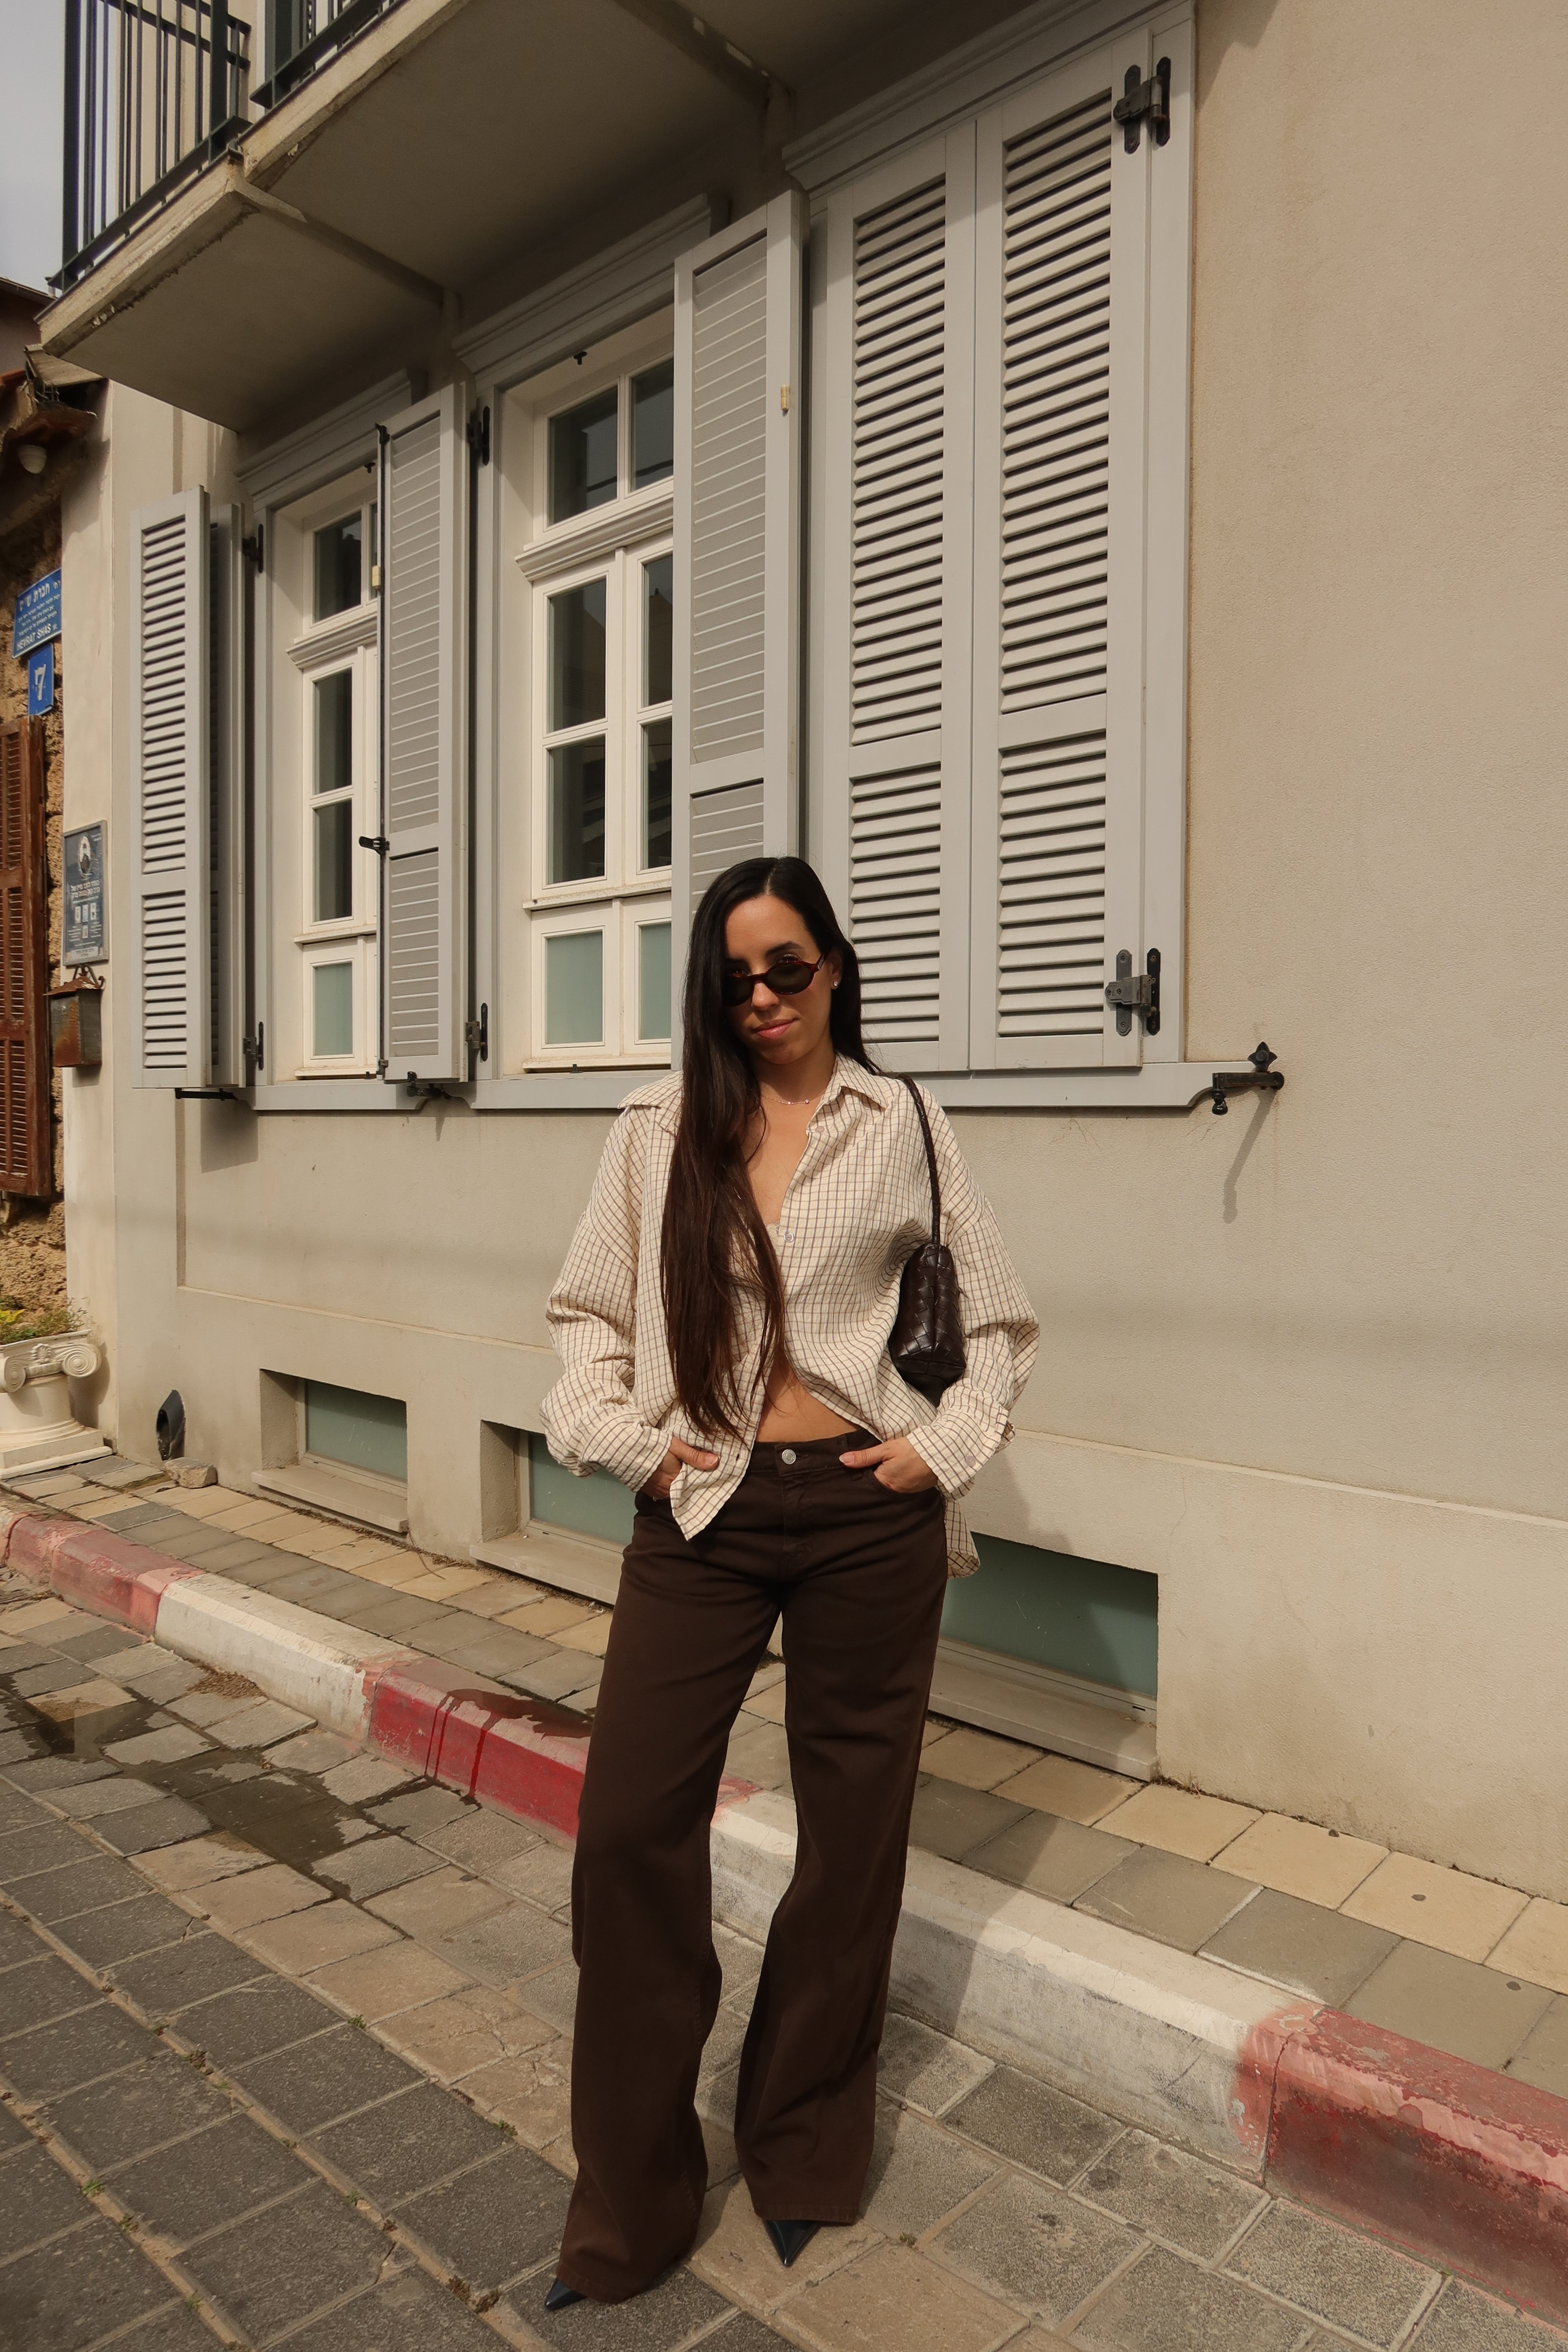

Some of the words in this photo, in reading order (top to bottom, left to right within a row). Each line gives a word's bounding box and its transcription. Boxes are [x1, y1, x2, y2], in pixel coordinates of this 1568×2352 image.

[34, 582, 50, 603] חברת
[17, 632, 36, 651] HEVRAT
[37, 622, 51, 639] SHAS
[34, 664, 46, 701] 7
